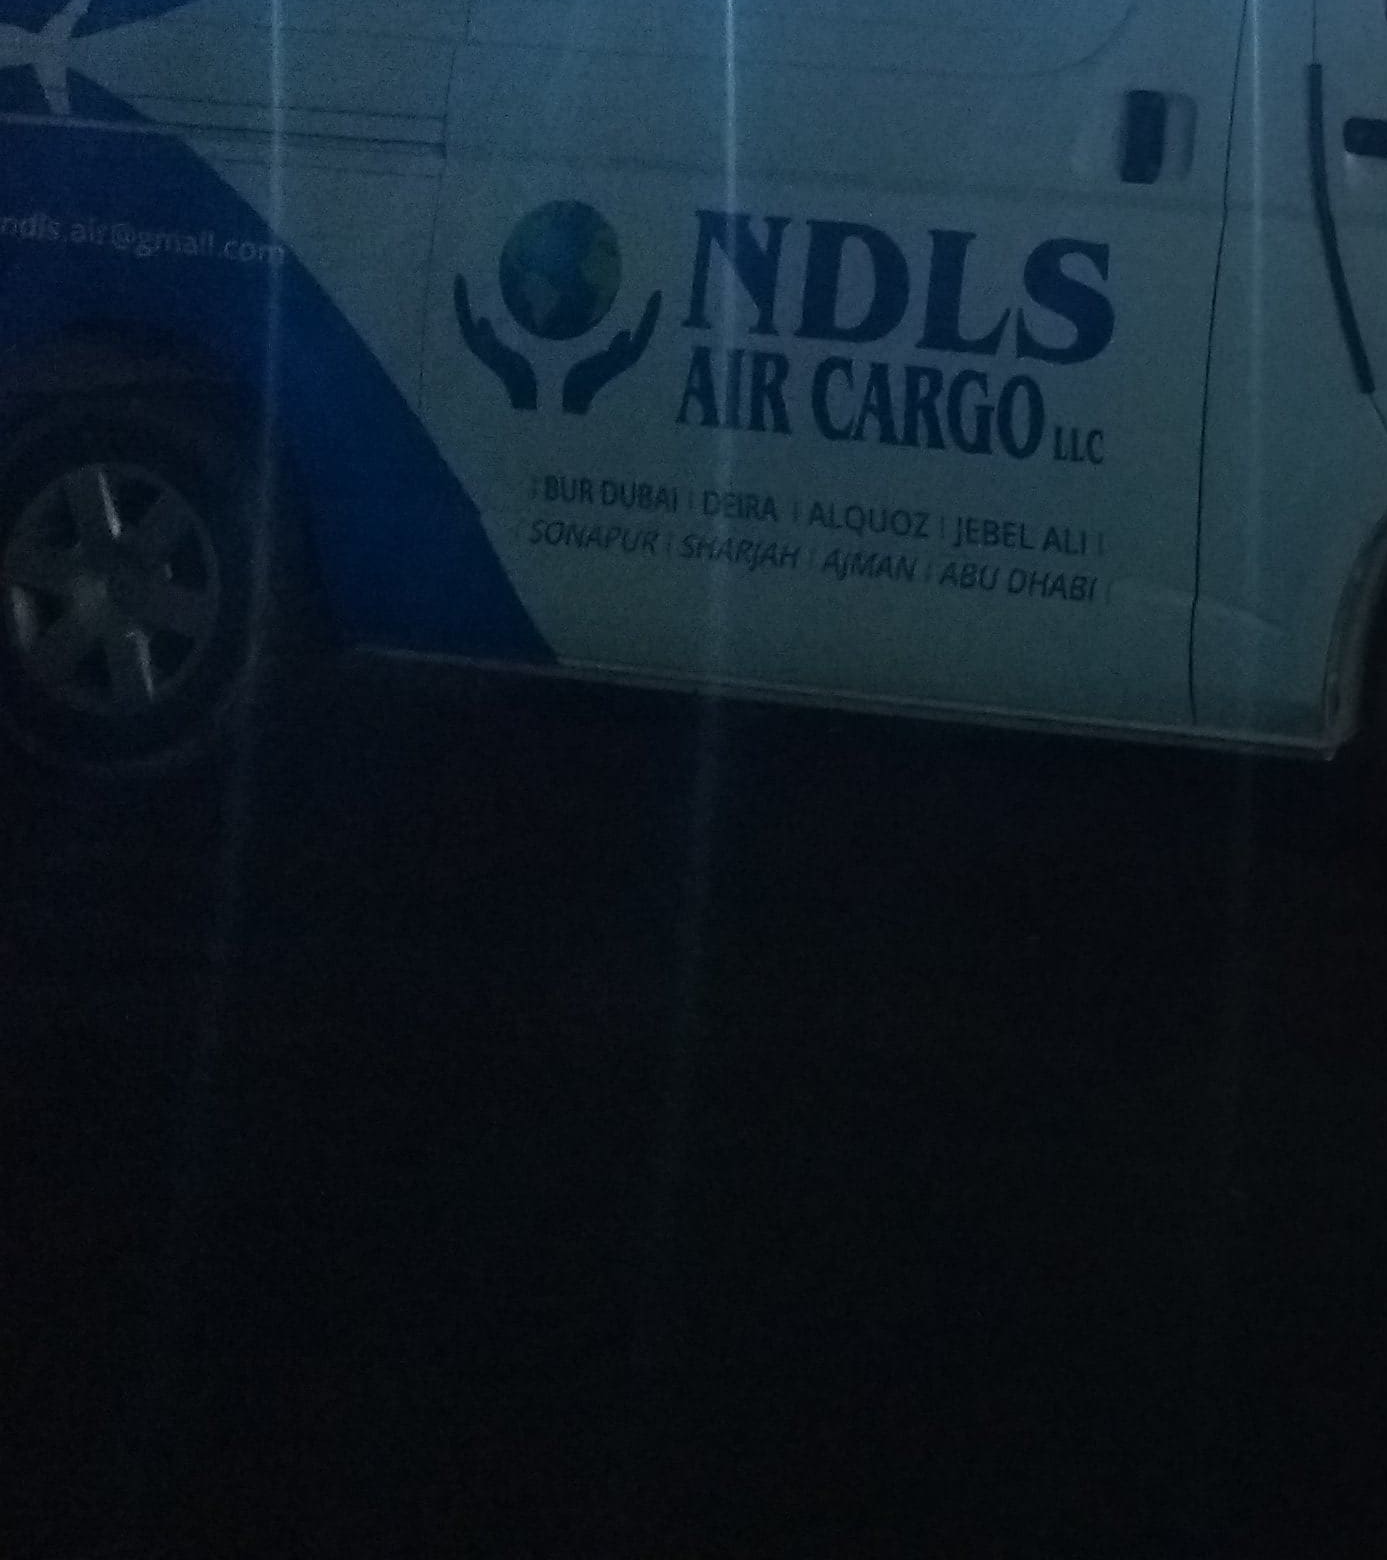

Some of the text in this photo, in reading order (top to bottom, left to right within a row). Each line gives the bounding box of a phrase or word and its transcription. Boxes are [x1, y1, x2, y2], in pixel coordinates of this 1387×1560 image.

[679, 206, 1117, 366] NDLS
[675, 345, 1106, 466] AIR CARGO LLC
[528, 519, 1100, 602] SONAPUR SHARJAH AJMAN ABU DHABI
[544, 474, 1088, 556] BUR DUBAI DEIRA ALQUOZ JEBEL ALI
